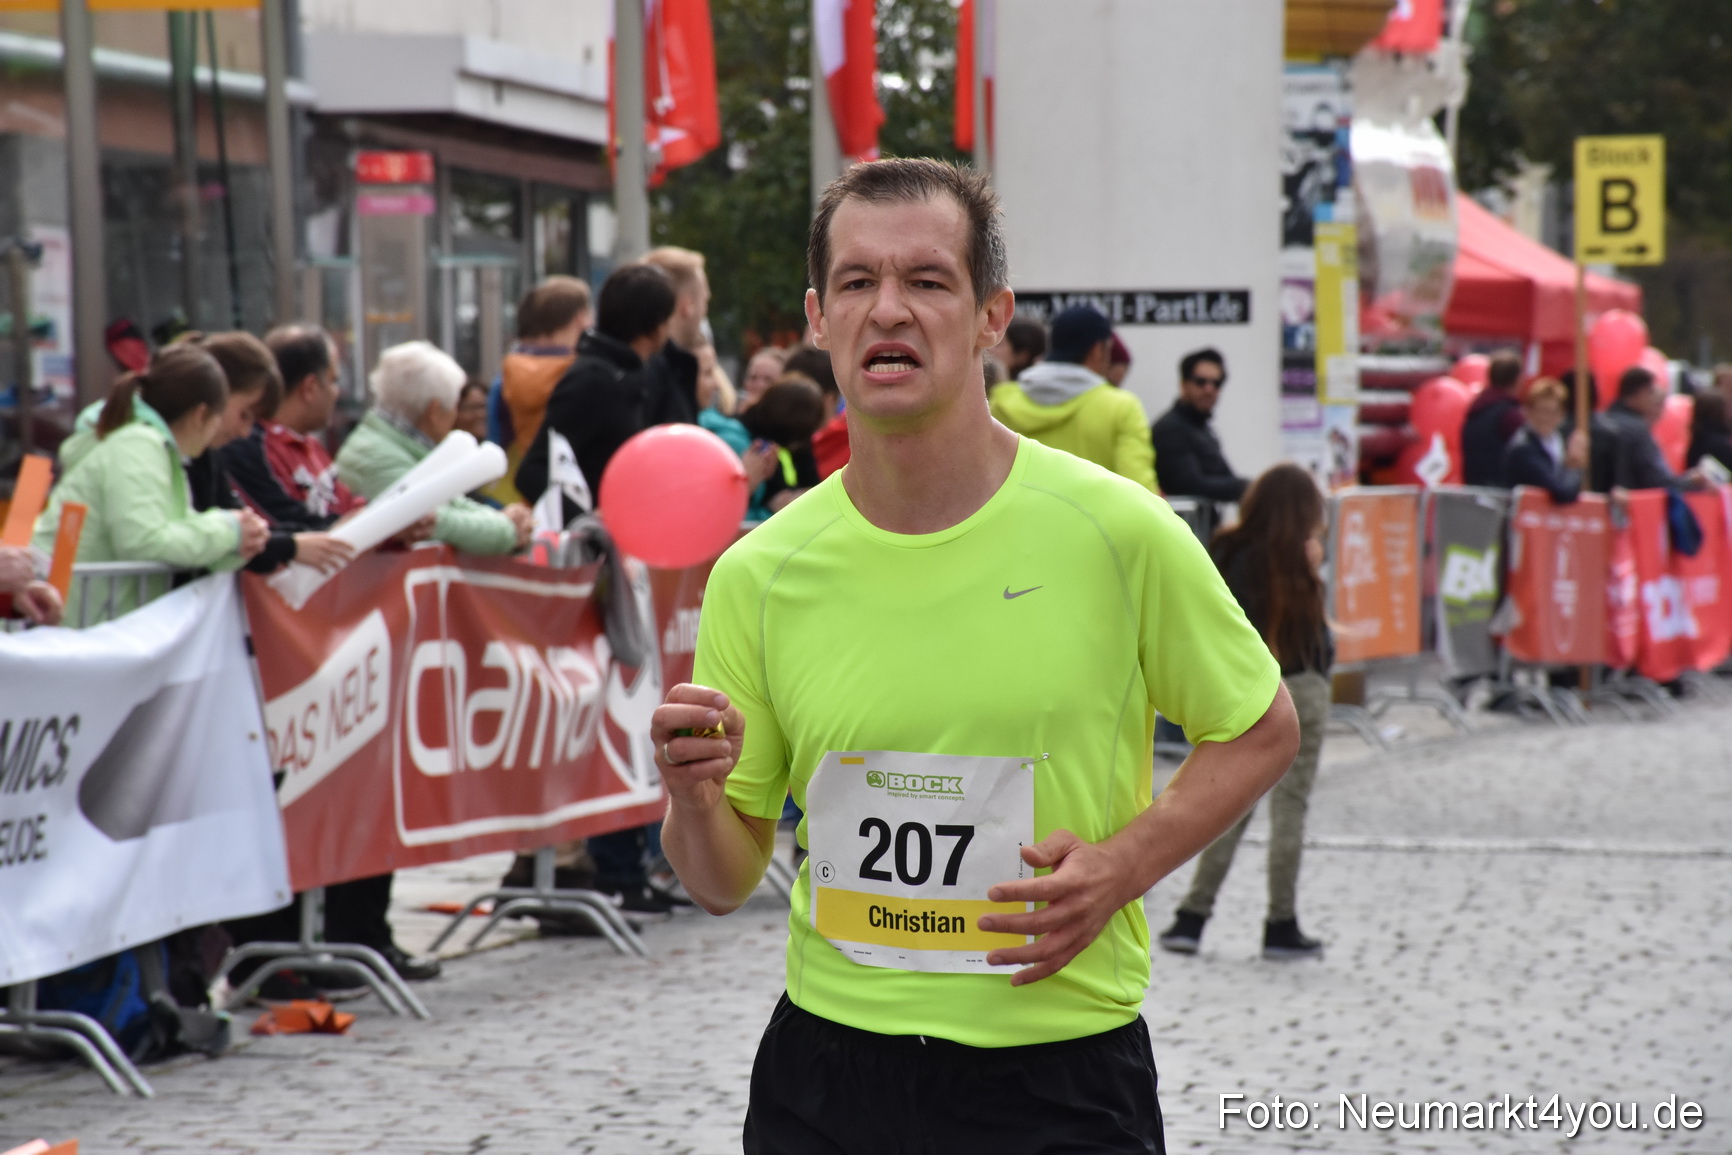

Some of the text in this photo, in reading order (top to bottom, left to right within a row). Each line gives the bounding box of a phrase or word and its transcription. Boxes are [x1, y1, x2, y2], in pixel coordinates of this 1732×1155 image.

[1600, 178, 1639, 235] B
[887, 772, 964, 794] BOCK
[859, 817, 975, 886] 207
[822, 866, 829, 878] C
[868, 905, 965, 934] Christian
